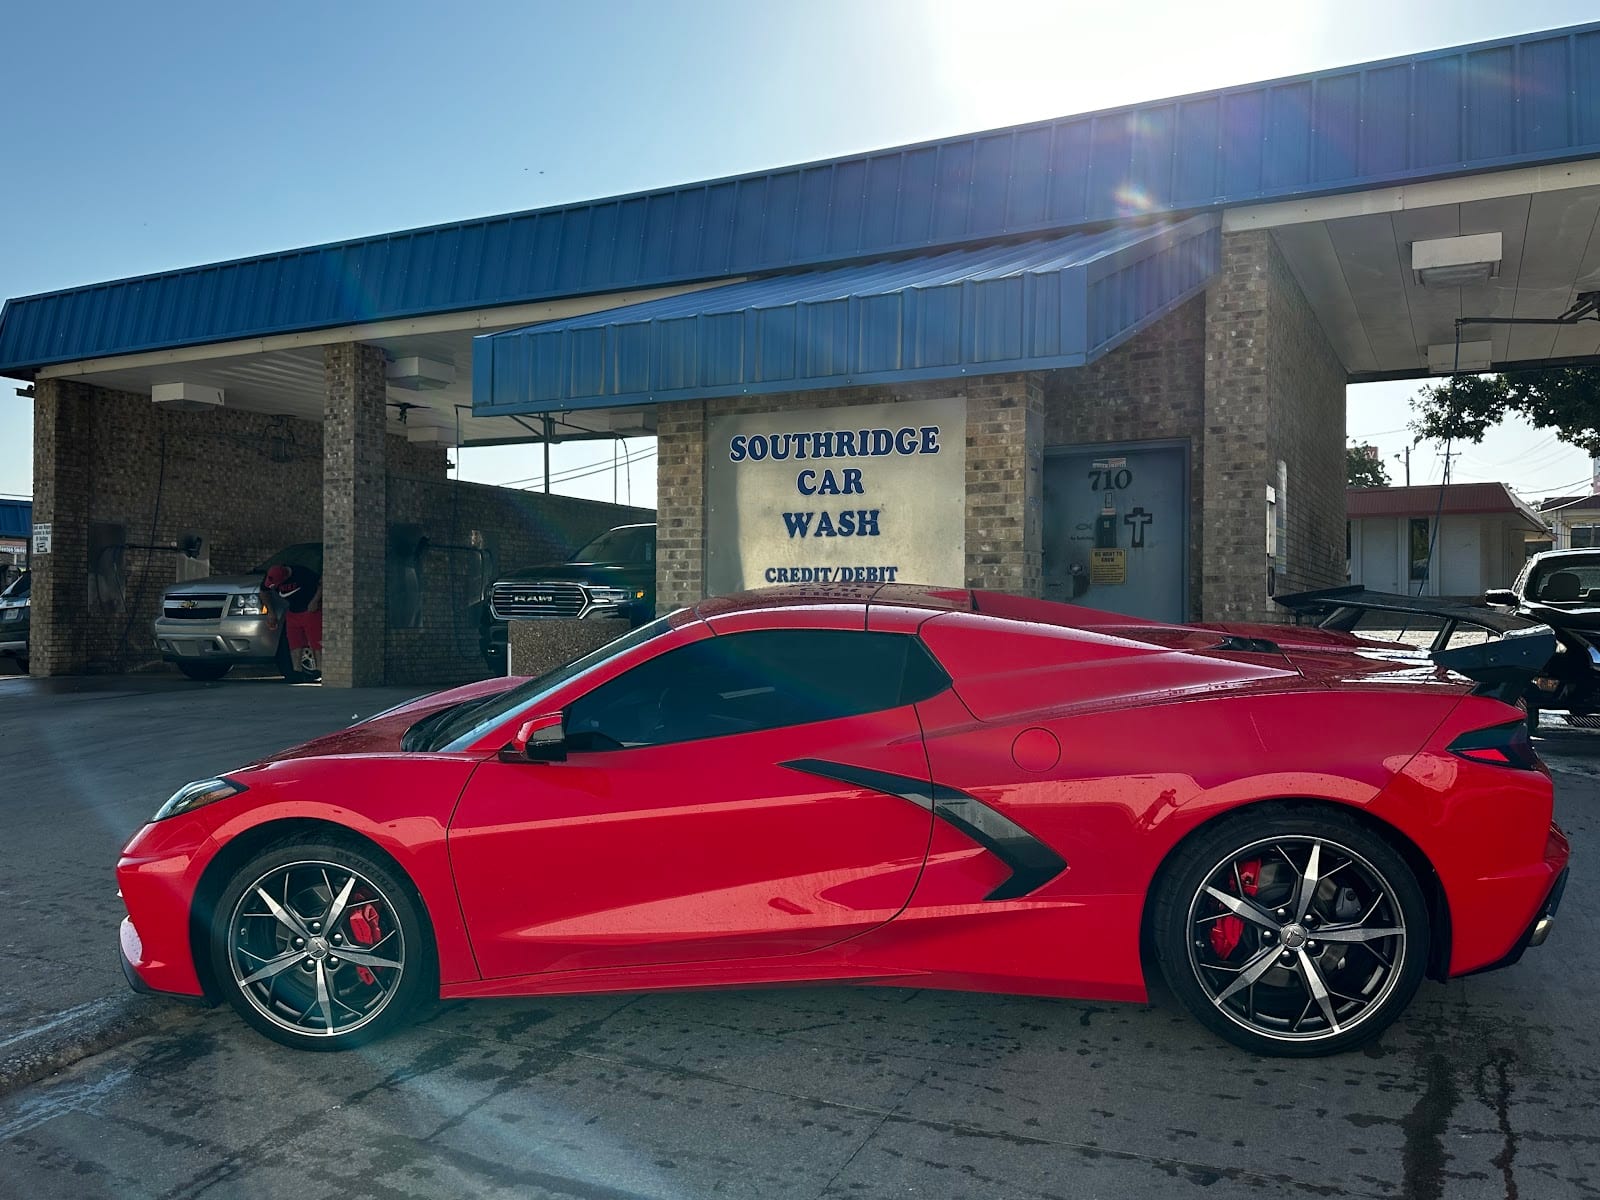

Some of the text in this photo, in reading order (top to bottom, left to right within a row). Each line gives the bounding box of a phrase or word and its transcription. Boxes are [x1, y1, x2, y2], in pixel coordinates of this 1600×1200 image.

[730, 426, 941, 462] SOUTHRIDGE
[797, 468, 865, 496] CAR
[1087, 469, 1133, 491] 710
[782, 509, 881, 539] WASH
[765, 566, 898, 583] CREDIT/DEBIT
[514, 595, 553, 603] RAM
